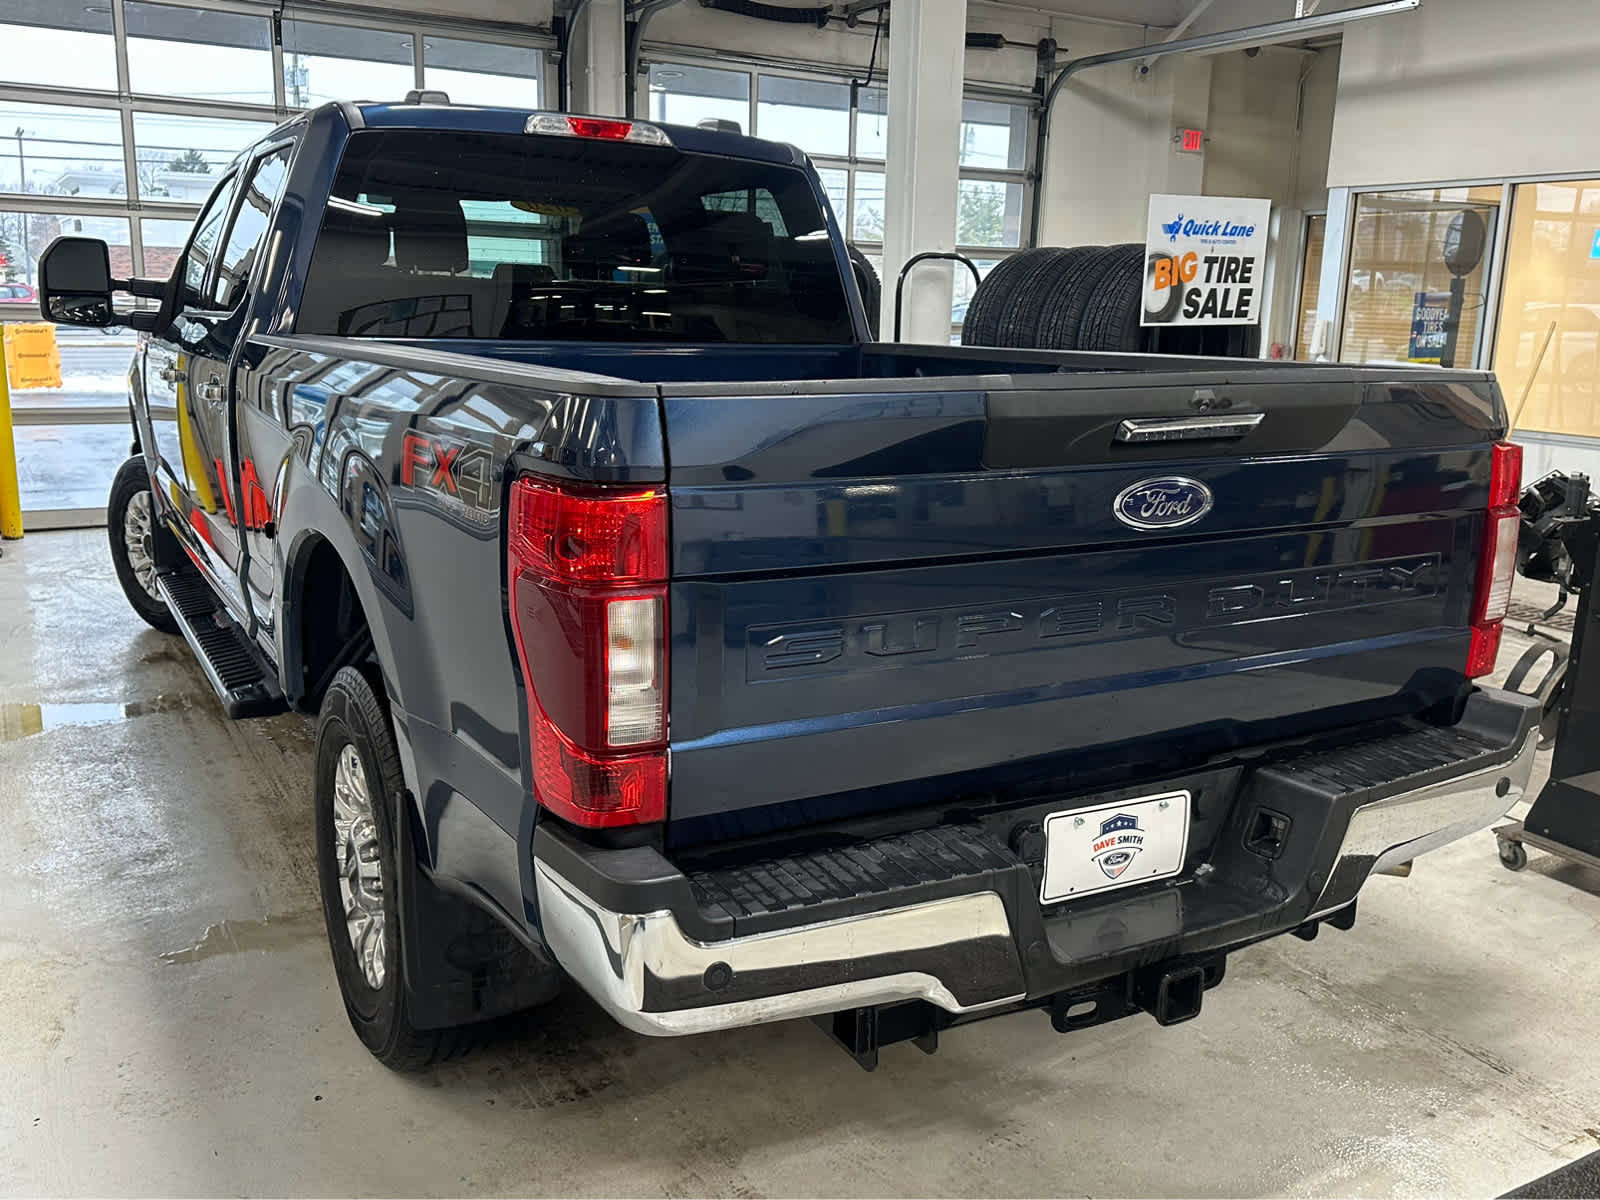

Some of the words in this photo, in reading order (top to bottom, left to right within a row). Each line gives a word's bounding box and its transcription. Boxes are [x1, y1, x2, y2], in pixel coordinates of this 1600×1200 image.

[1183, 219, 1222, 237] Quick
[1222, 220, 1254, 237] Lane
[1154, 251, 1198, 291] BIG
[1204, 256, 1255, 284] TIRE
[1183, 287, 1253, 319] SALE
[1416, 307, 1449, 320] GOODYEA
[401, 428, 493, 512] FX4
[1137, 487, 1193, 518] Ford
[762, 593, 1177, 671] SUPER
[1207, 561, 1433, 618] DUTY
[1093, 837, 1116, 852] DAVE
[1117, 835, 1143, 845] SMITH
